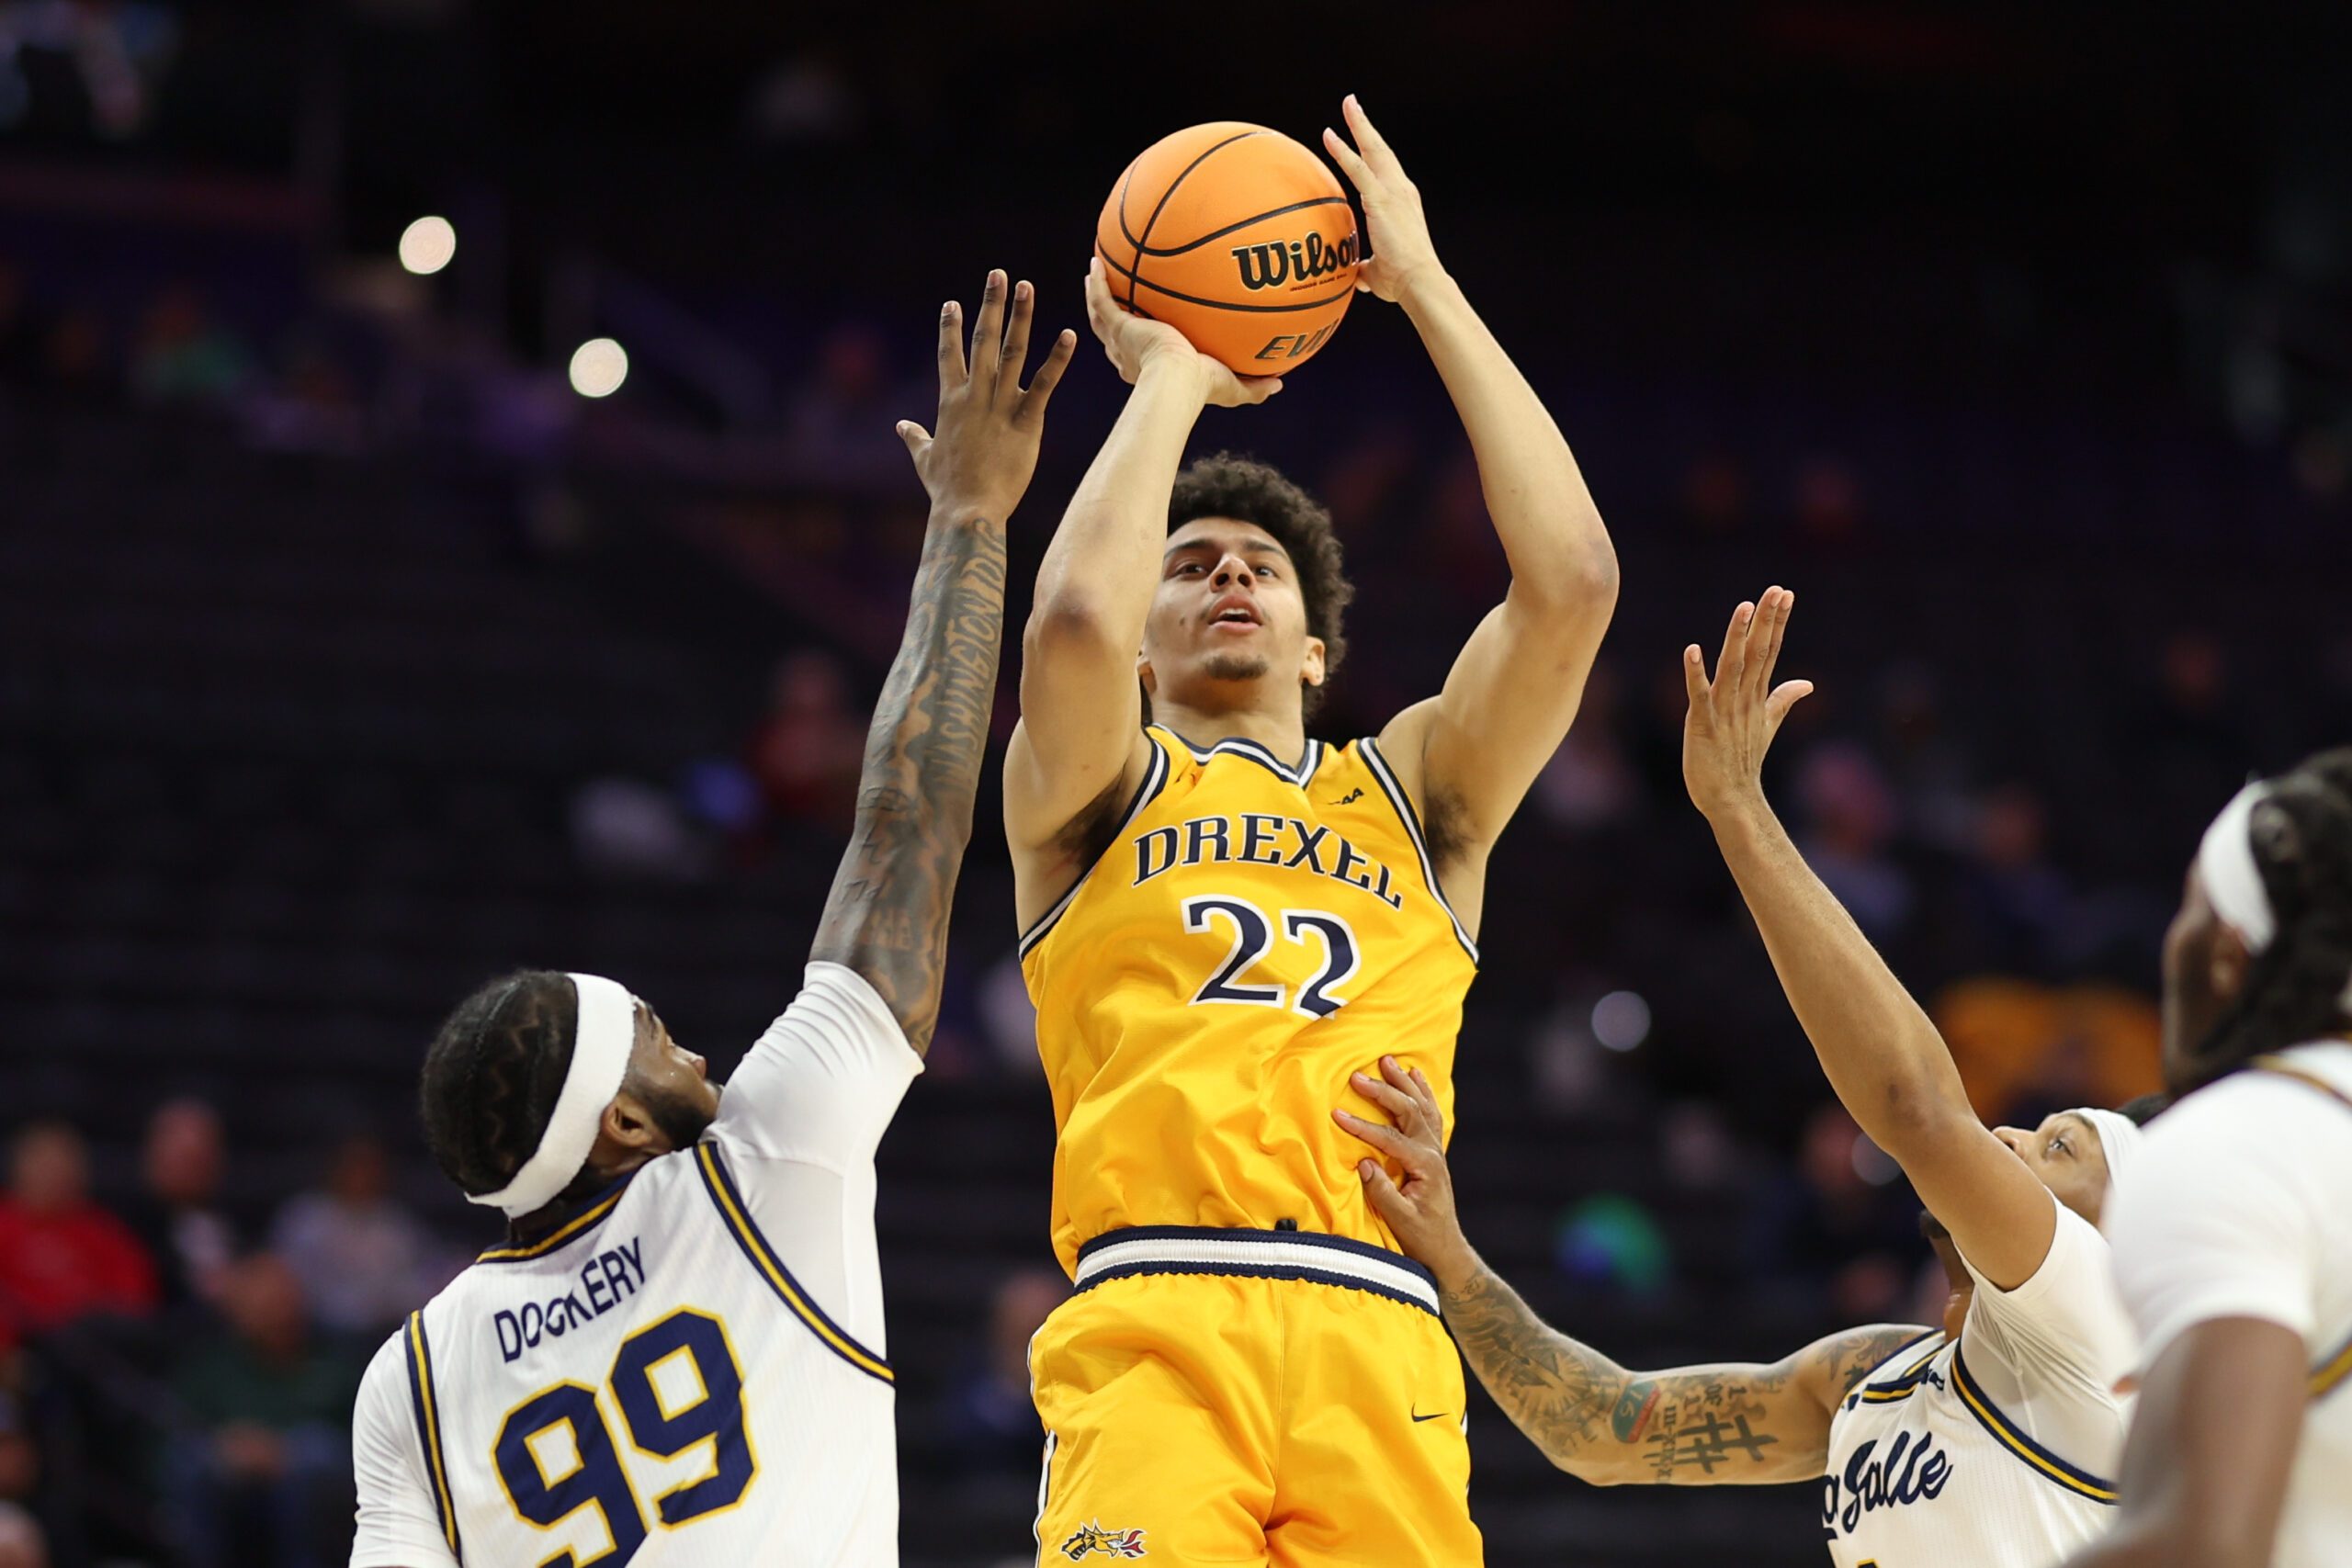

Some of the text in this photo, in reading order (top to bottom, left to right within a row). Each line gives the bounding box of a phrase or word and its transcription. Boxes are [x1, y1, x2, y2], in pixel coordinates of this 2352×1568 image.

[1132, 813, 1404, 912] DREXEL
[1180, 894, 1362, 1021] 22
[494, 1236, 645, 1363] DOCKERY
[490, 1304, 761, 1568] 99
[1841, 1430, 1953, 1534] Salle
